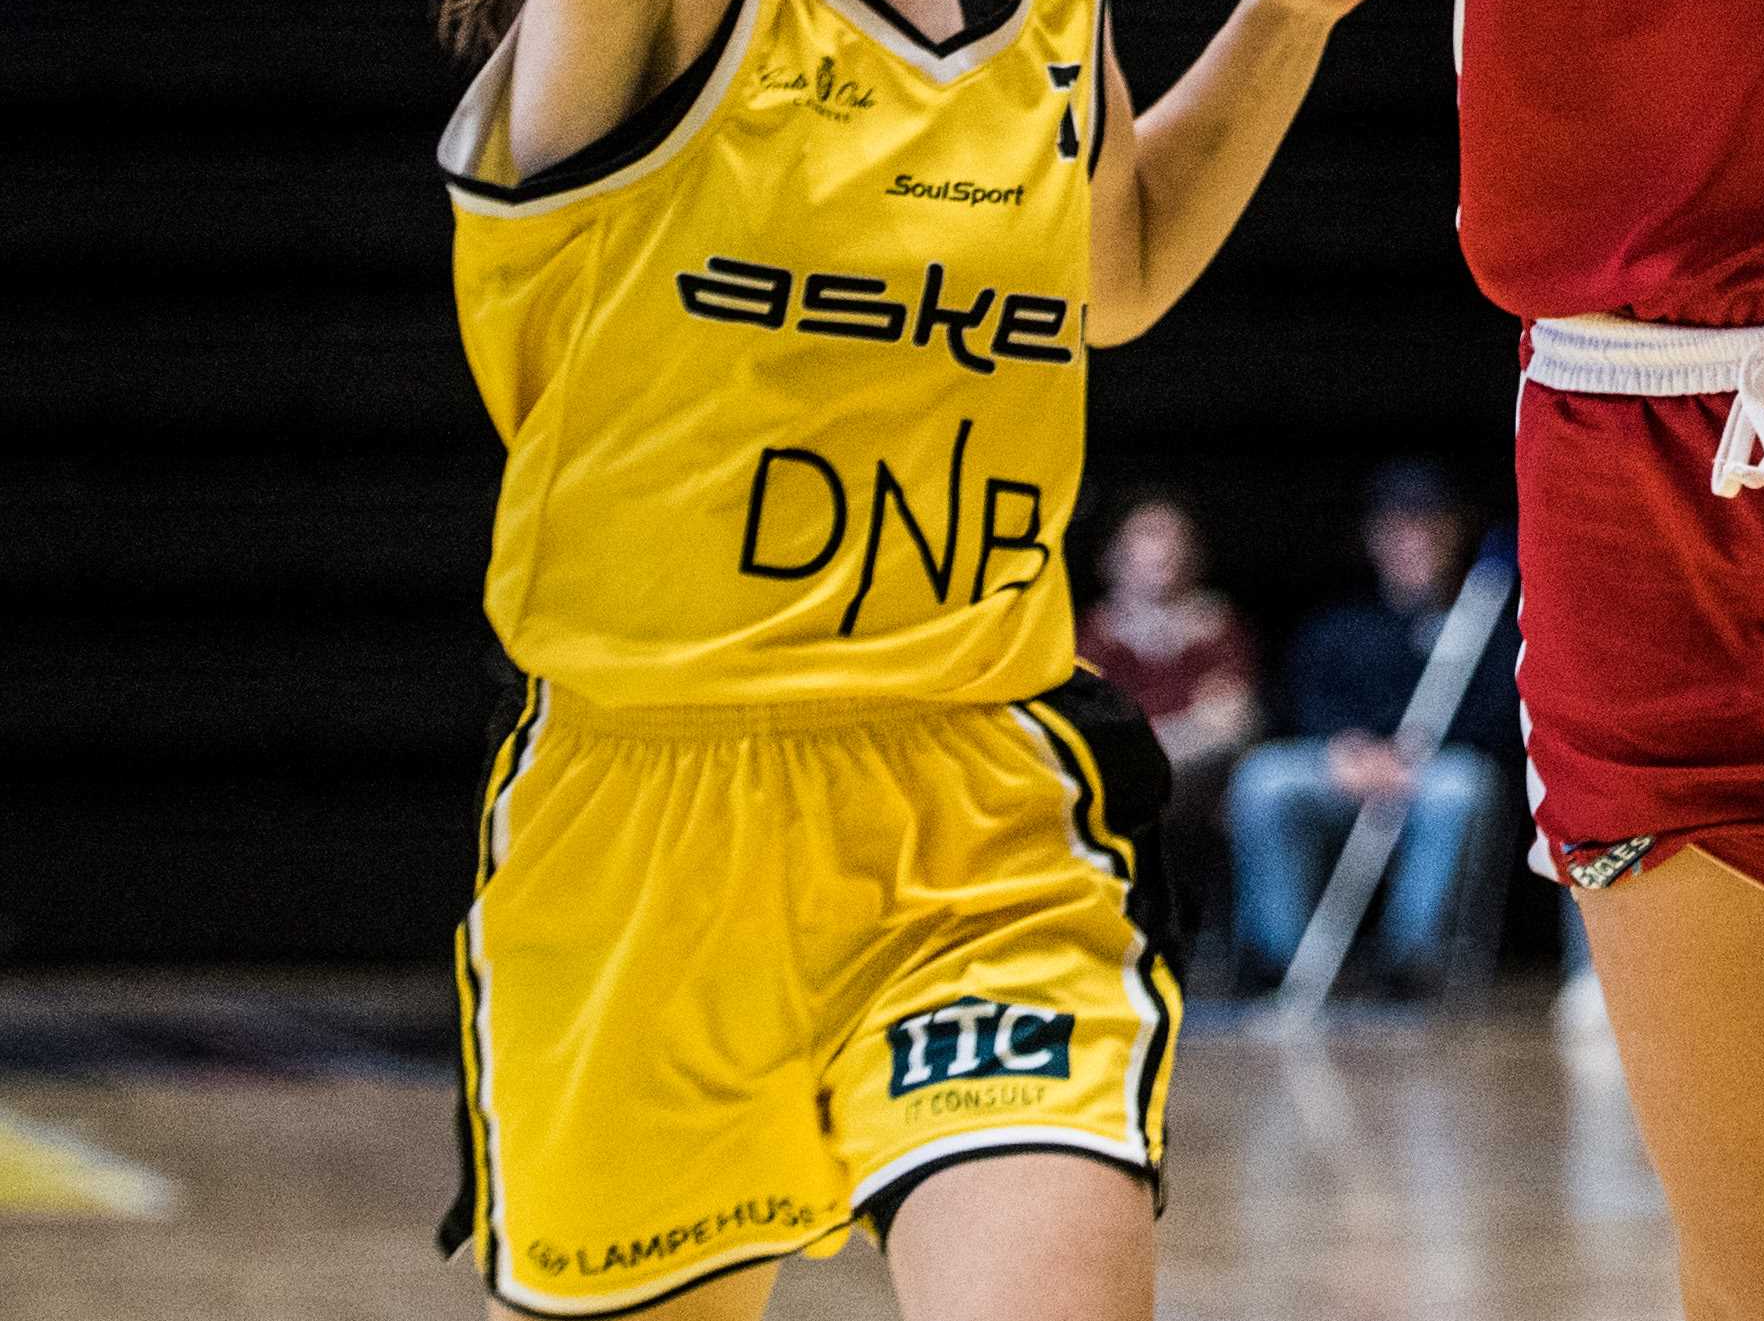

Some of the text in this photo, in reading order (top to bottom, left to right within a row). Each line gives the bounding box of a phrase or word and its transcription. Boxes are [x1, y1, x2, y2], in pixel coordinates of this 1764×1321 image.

[885, 173, 1025, 207] SoulSport
[676, 256, 1090, 373] aske
[739, 418, 1050, 636] DNB
[900, 1002, 1058, 1086] ITC
